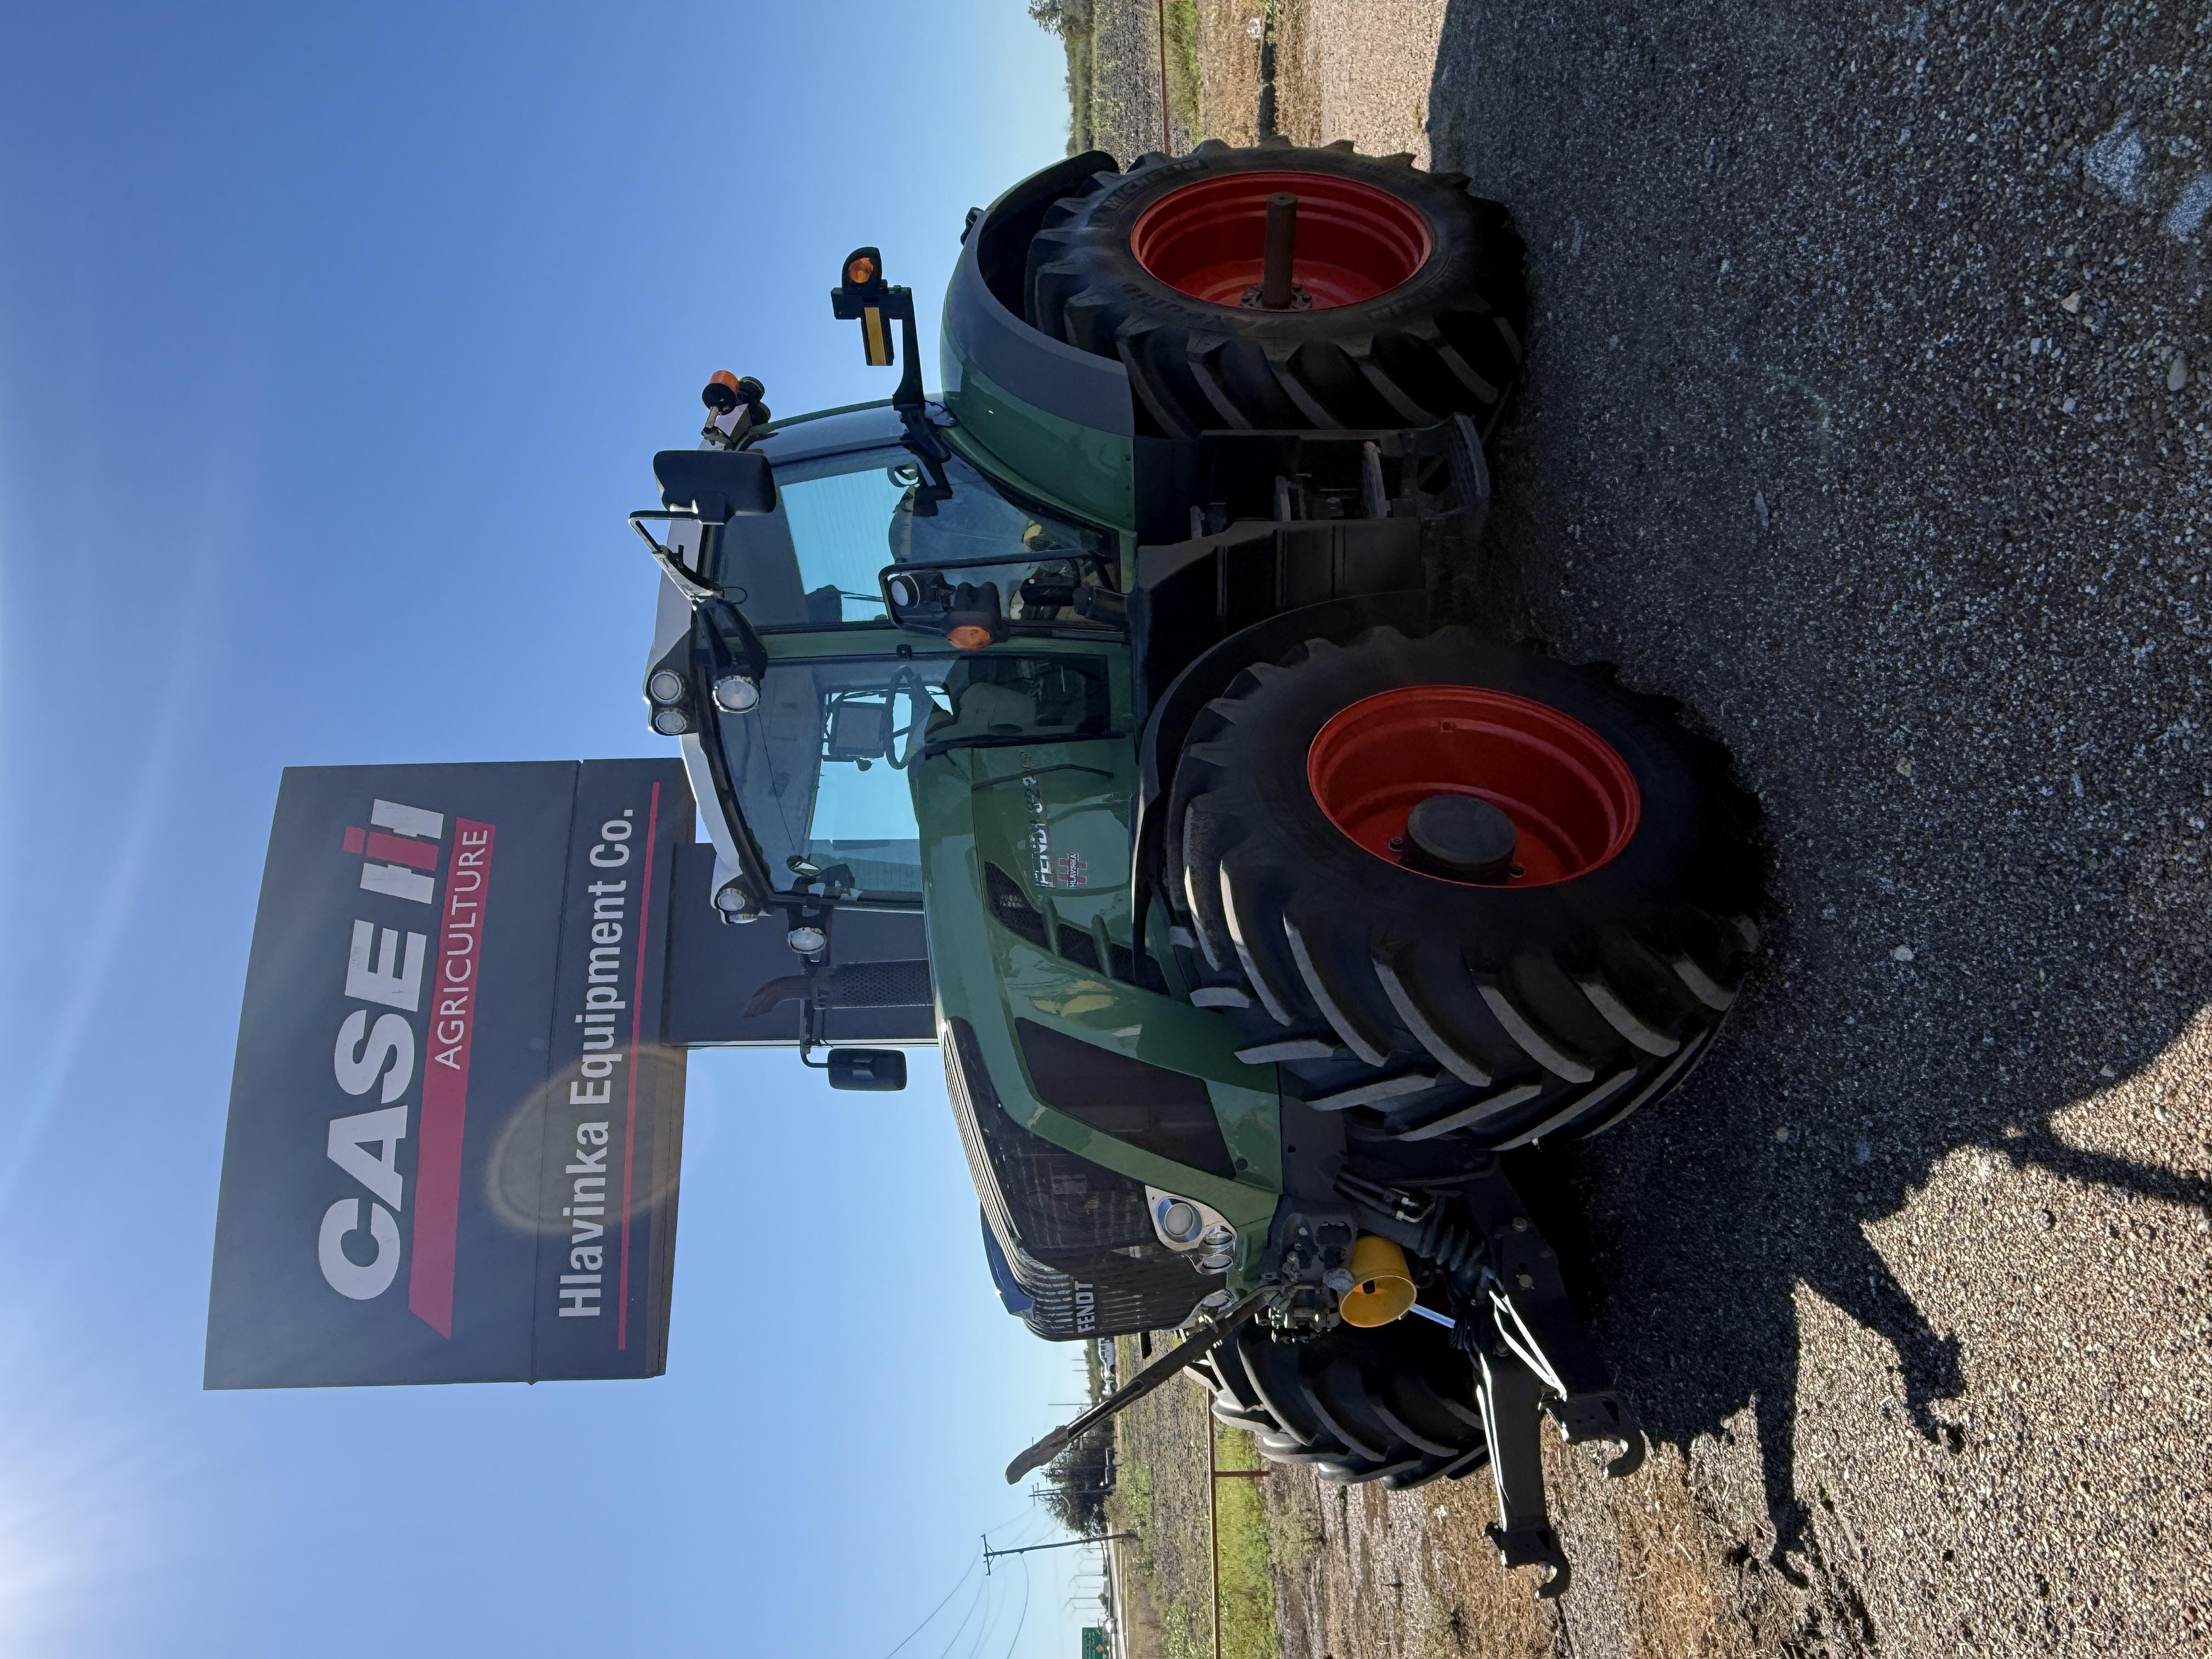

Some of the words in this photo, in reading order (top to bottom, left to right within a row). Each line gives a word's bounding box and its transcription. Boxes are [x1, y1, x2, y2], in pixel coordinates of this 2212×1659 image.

[1103, 160, 1201, 209] MICHIN
[343, 798, 443, 904] IH
[590, 809, 633, 867] Co.
[434, 830, 488, 1070] AGRICULTURE
[569, 881, 627, 1104] Equipment
[318, 919, 427, 1300] CASE
[558, 1121, 610, 1317] Hlavinka
[1075, 1280, 1096, 1333] FENDT
